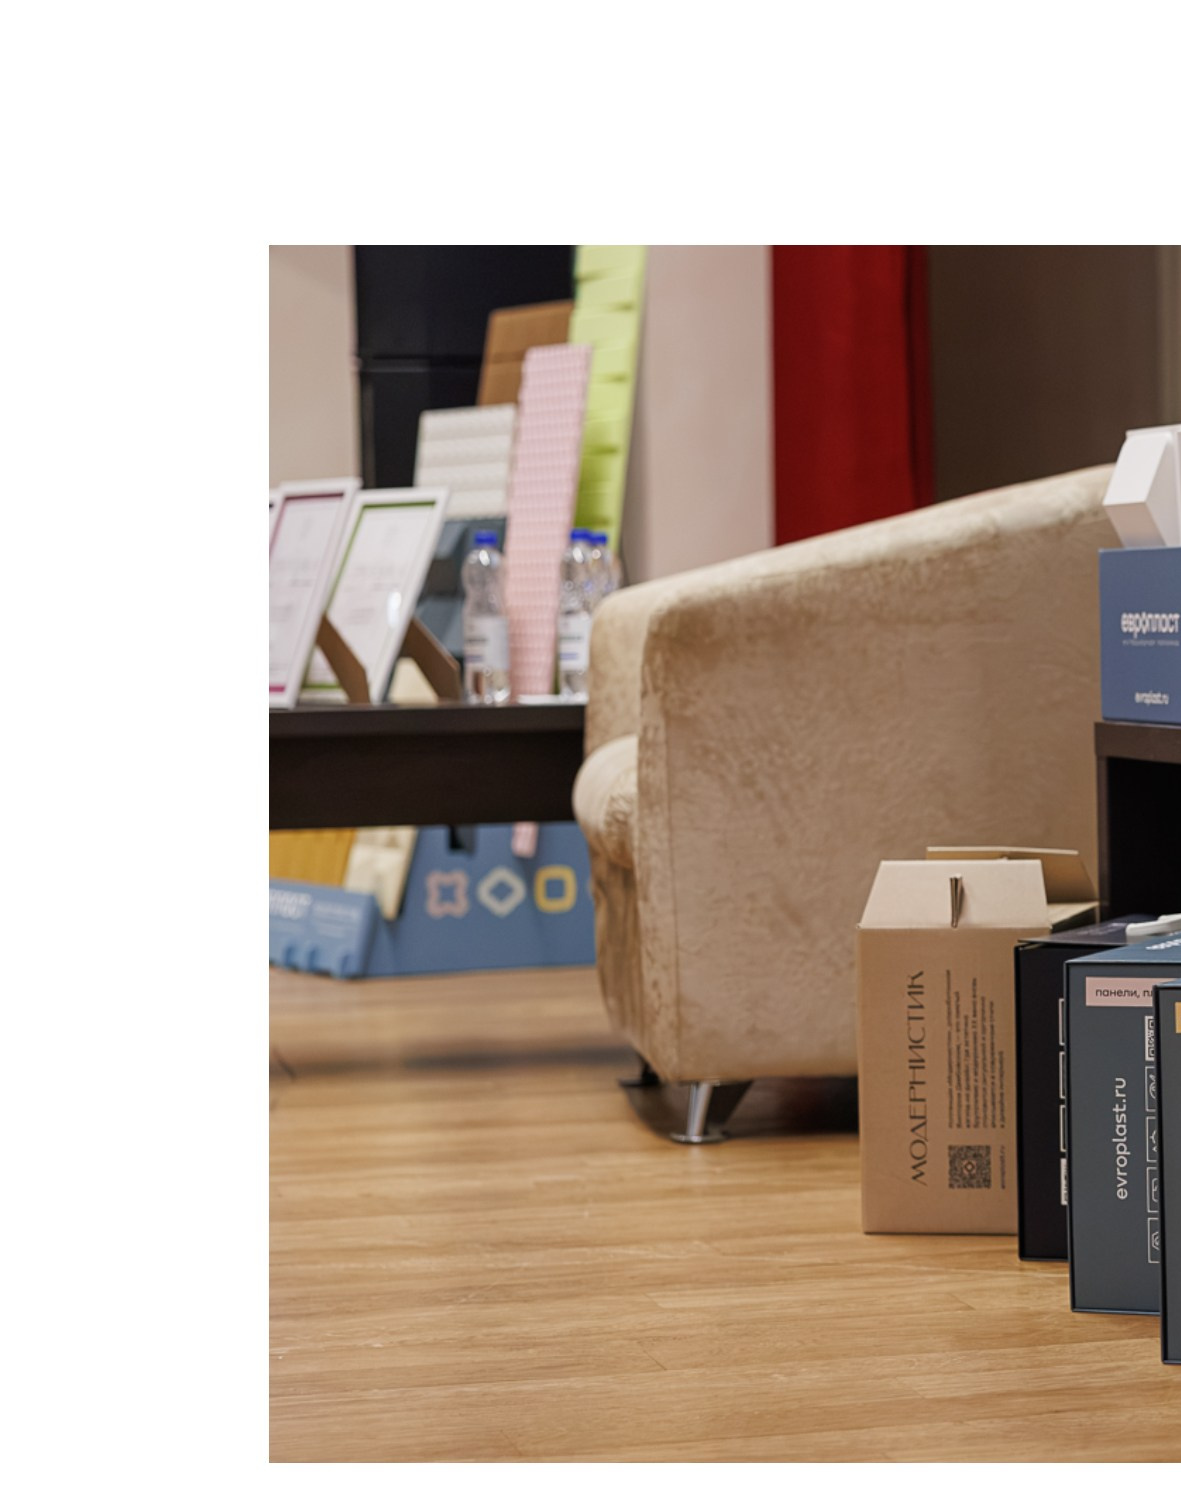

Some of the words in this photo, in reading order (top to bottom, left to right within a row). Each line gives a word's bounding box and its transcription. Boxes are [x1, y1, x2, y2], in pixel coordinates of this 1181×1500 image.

[1120, 611, 1181, 639] европласт
[1135, 689, 1170, 707] evroplast.ru
[1095, 988, 1140, 998] панели,
[906, 970, 930, 1187] МОДЕРНИСТИК
[1111, 1076, 1131, 1200] evroplast.ru
